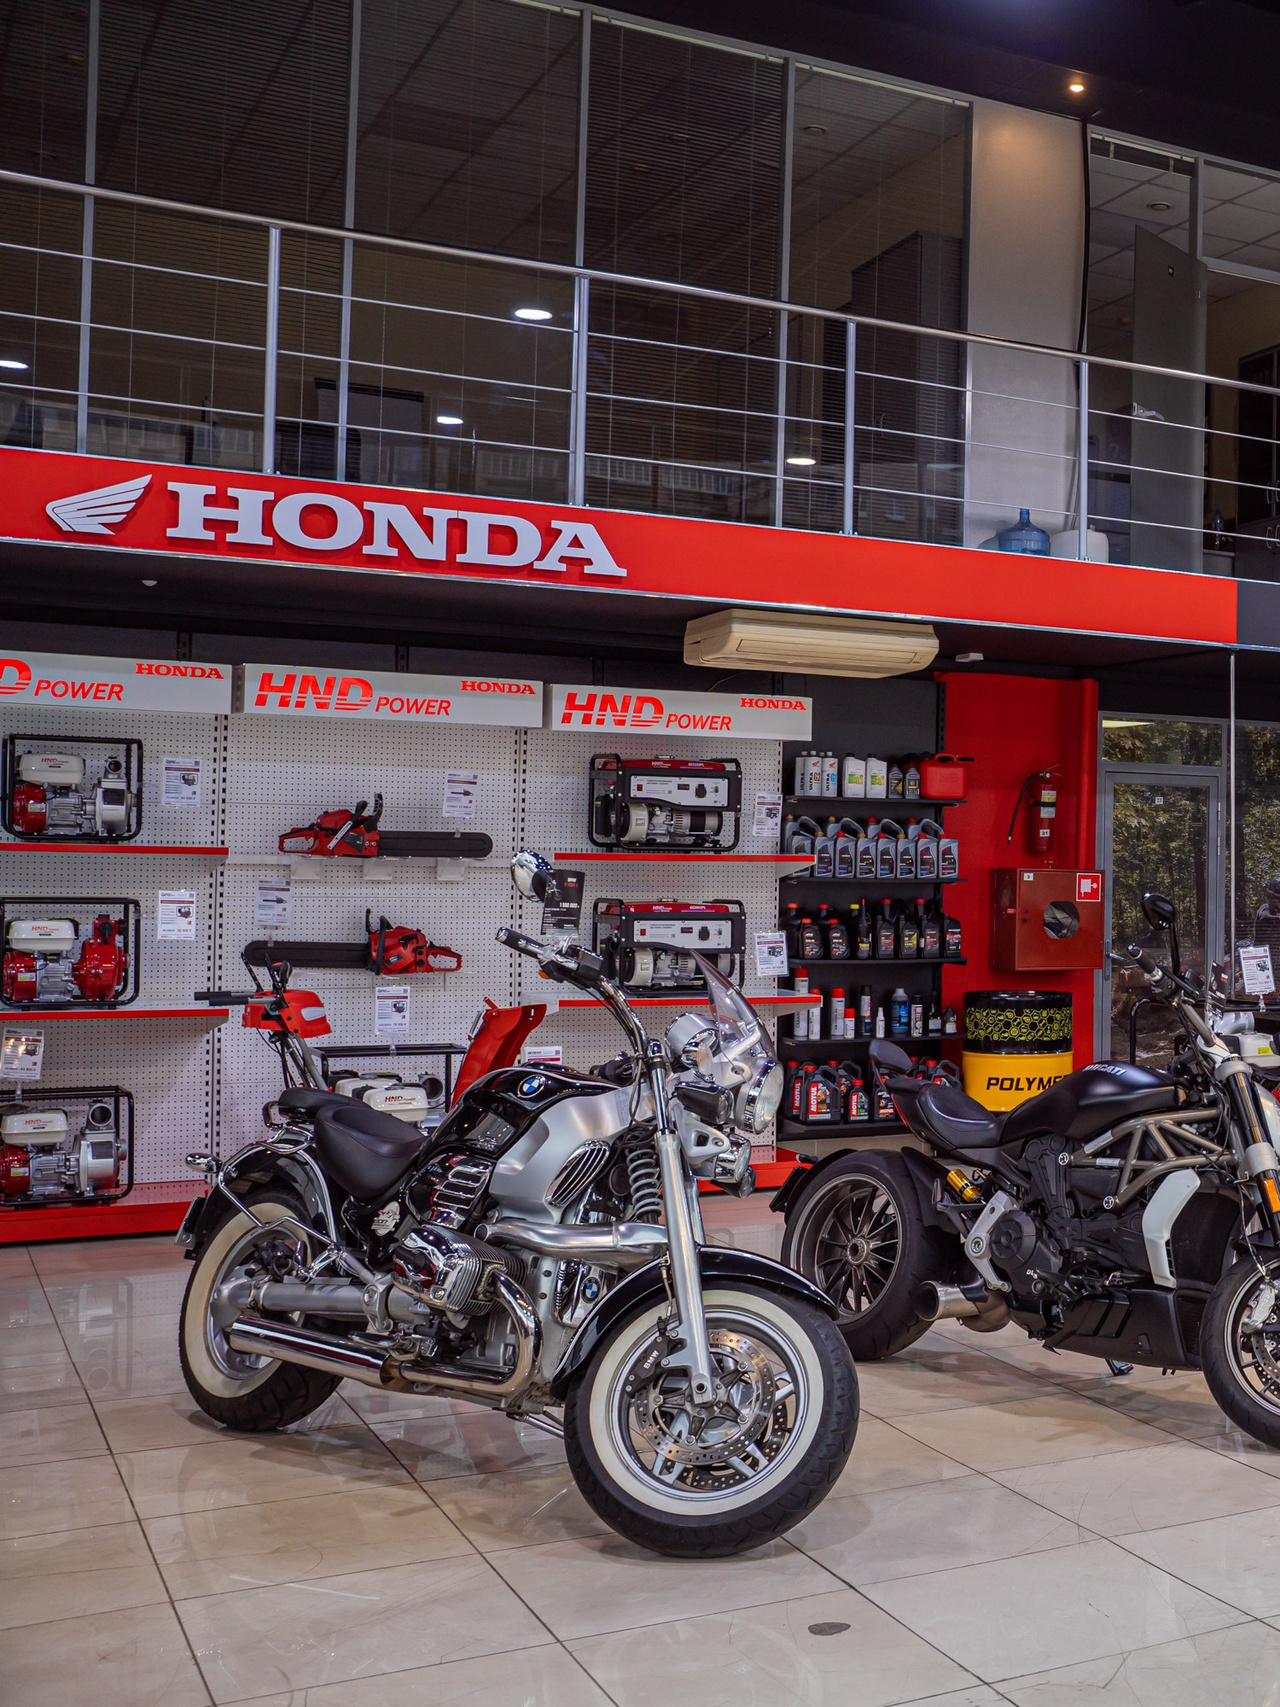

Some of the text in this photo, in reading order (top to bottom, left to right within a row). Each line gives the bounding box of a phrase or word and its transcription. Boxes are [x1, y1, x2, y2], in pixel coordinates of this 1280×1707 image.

[166, 481, 627, 577] HONDA
[135, 662, 224, 680] HONDA
[33, 679, 124, 701] POWER
[254, 672, 452, 716] HND POWER
[460, 680, 537, 695] HONDA
[560, 692, 733, 731] HND POWER
[739, 697, 807, 711] HONDA
[384, 1095, 404, 1103] HND
[643, 1350, 660, 1369] BMW
